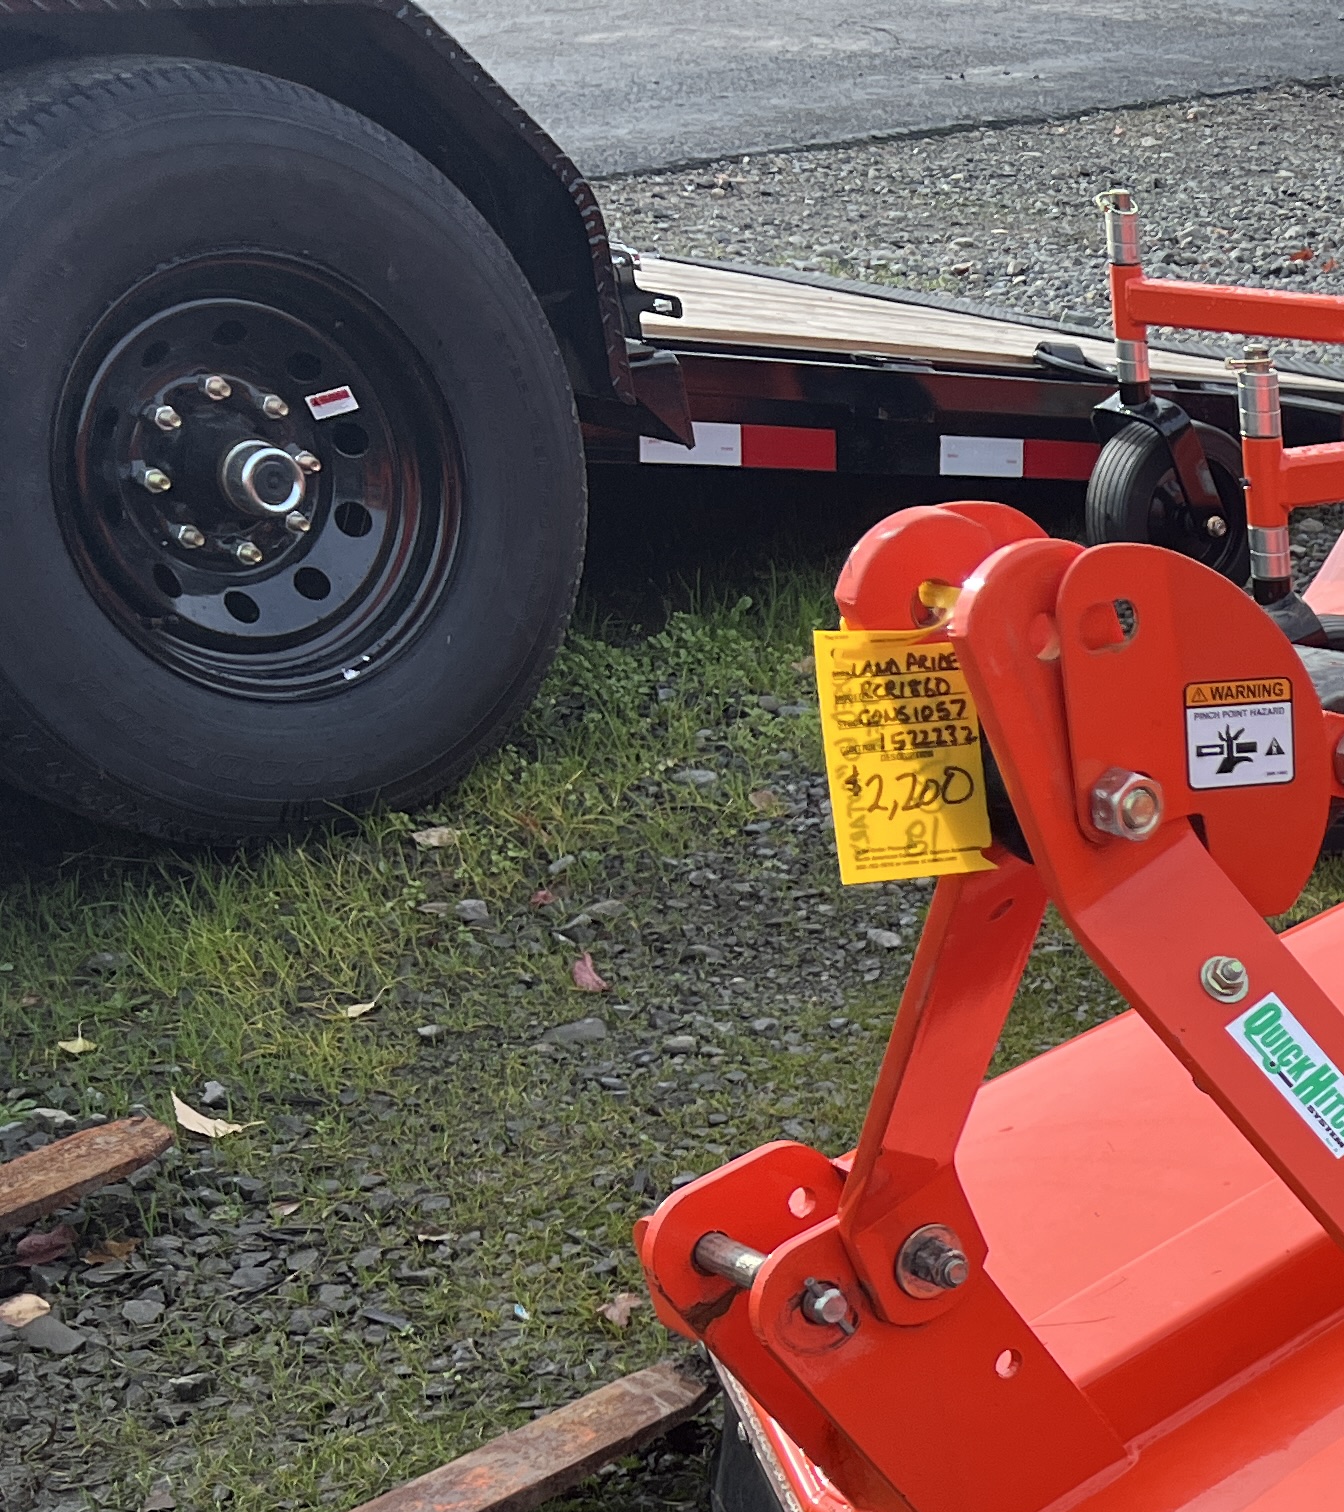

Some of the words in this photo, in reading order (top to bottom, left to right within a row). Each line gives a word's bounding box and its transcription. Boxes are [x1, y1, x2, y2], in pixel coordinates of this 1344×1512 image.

[1209, 681, 1285, 702] WARNING
[1193, 711, 1221, 721] PINCH
[1222, 709, 1249, 719] POINT
[1249, 706, 1286, 717] HAZARD
